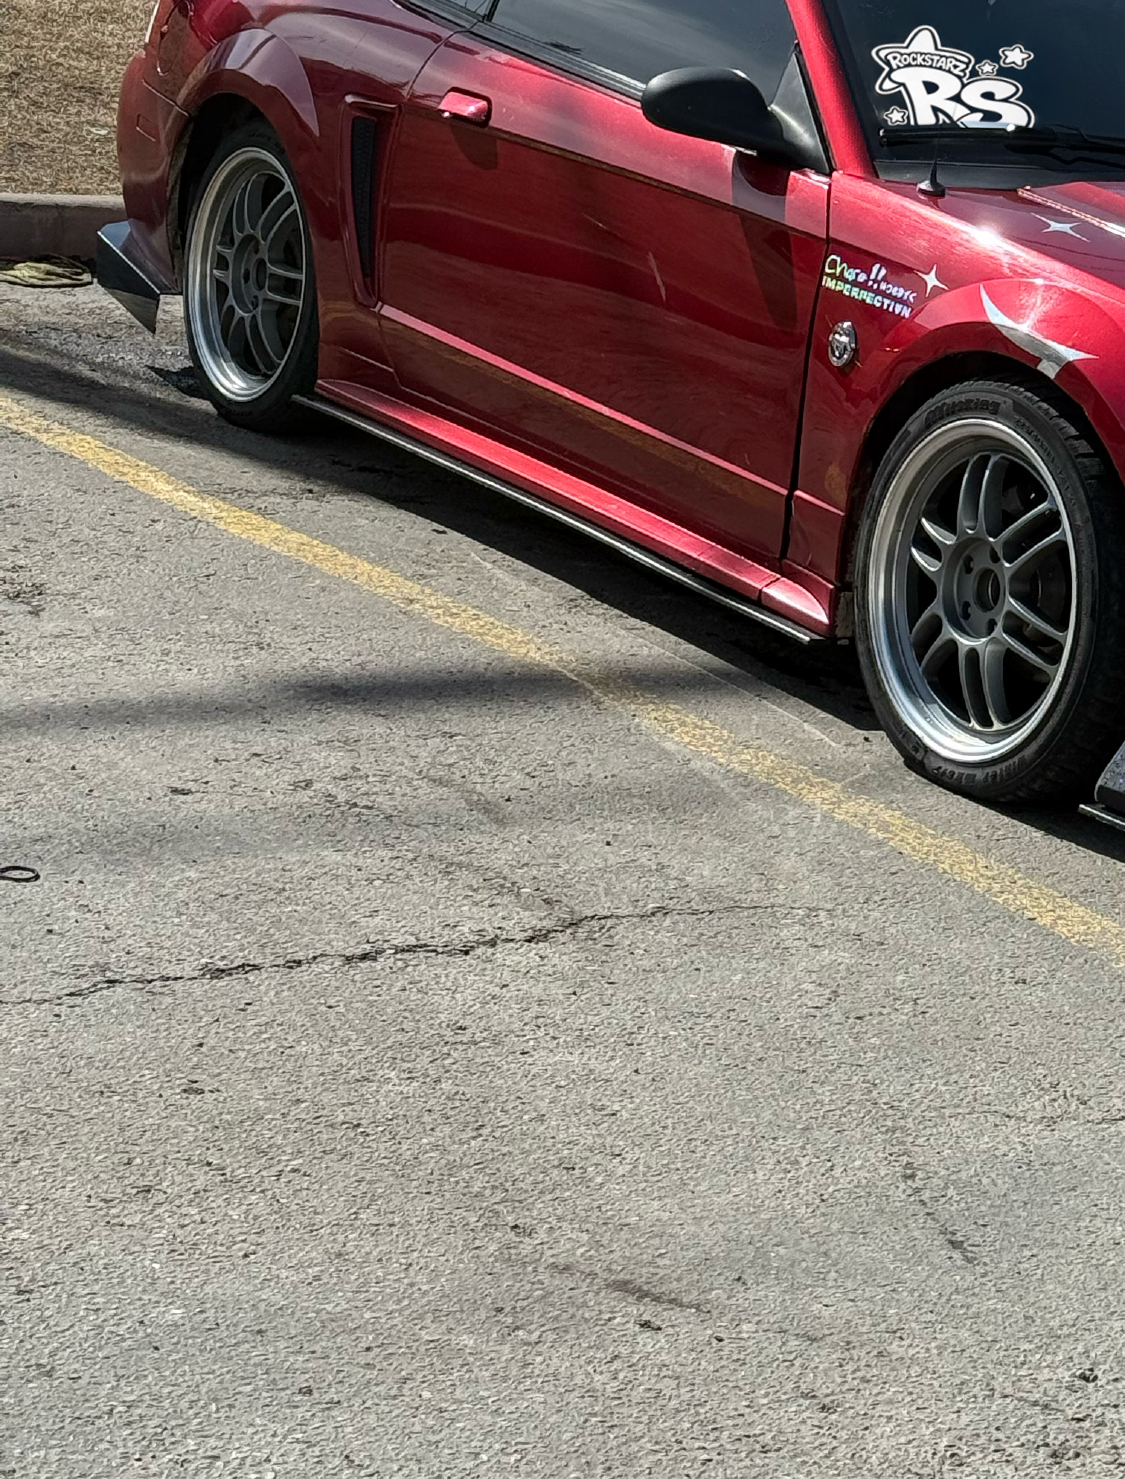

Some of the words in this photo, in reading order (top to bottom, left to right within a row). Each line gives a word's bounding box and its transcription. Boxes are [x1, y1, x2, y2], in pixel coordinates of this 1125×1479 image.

[886, 52, 967, 77] ROCKSTARZ
[889, 67, 1032, 128] RS
[821, 275, 912, 319] IMPERFECTION
